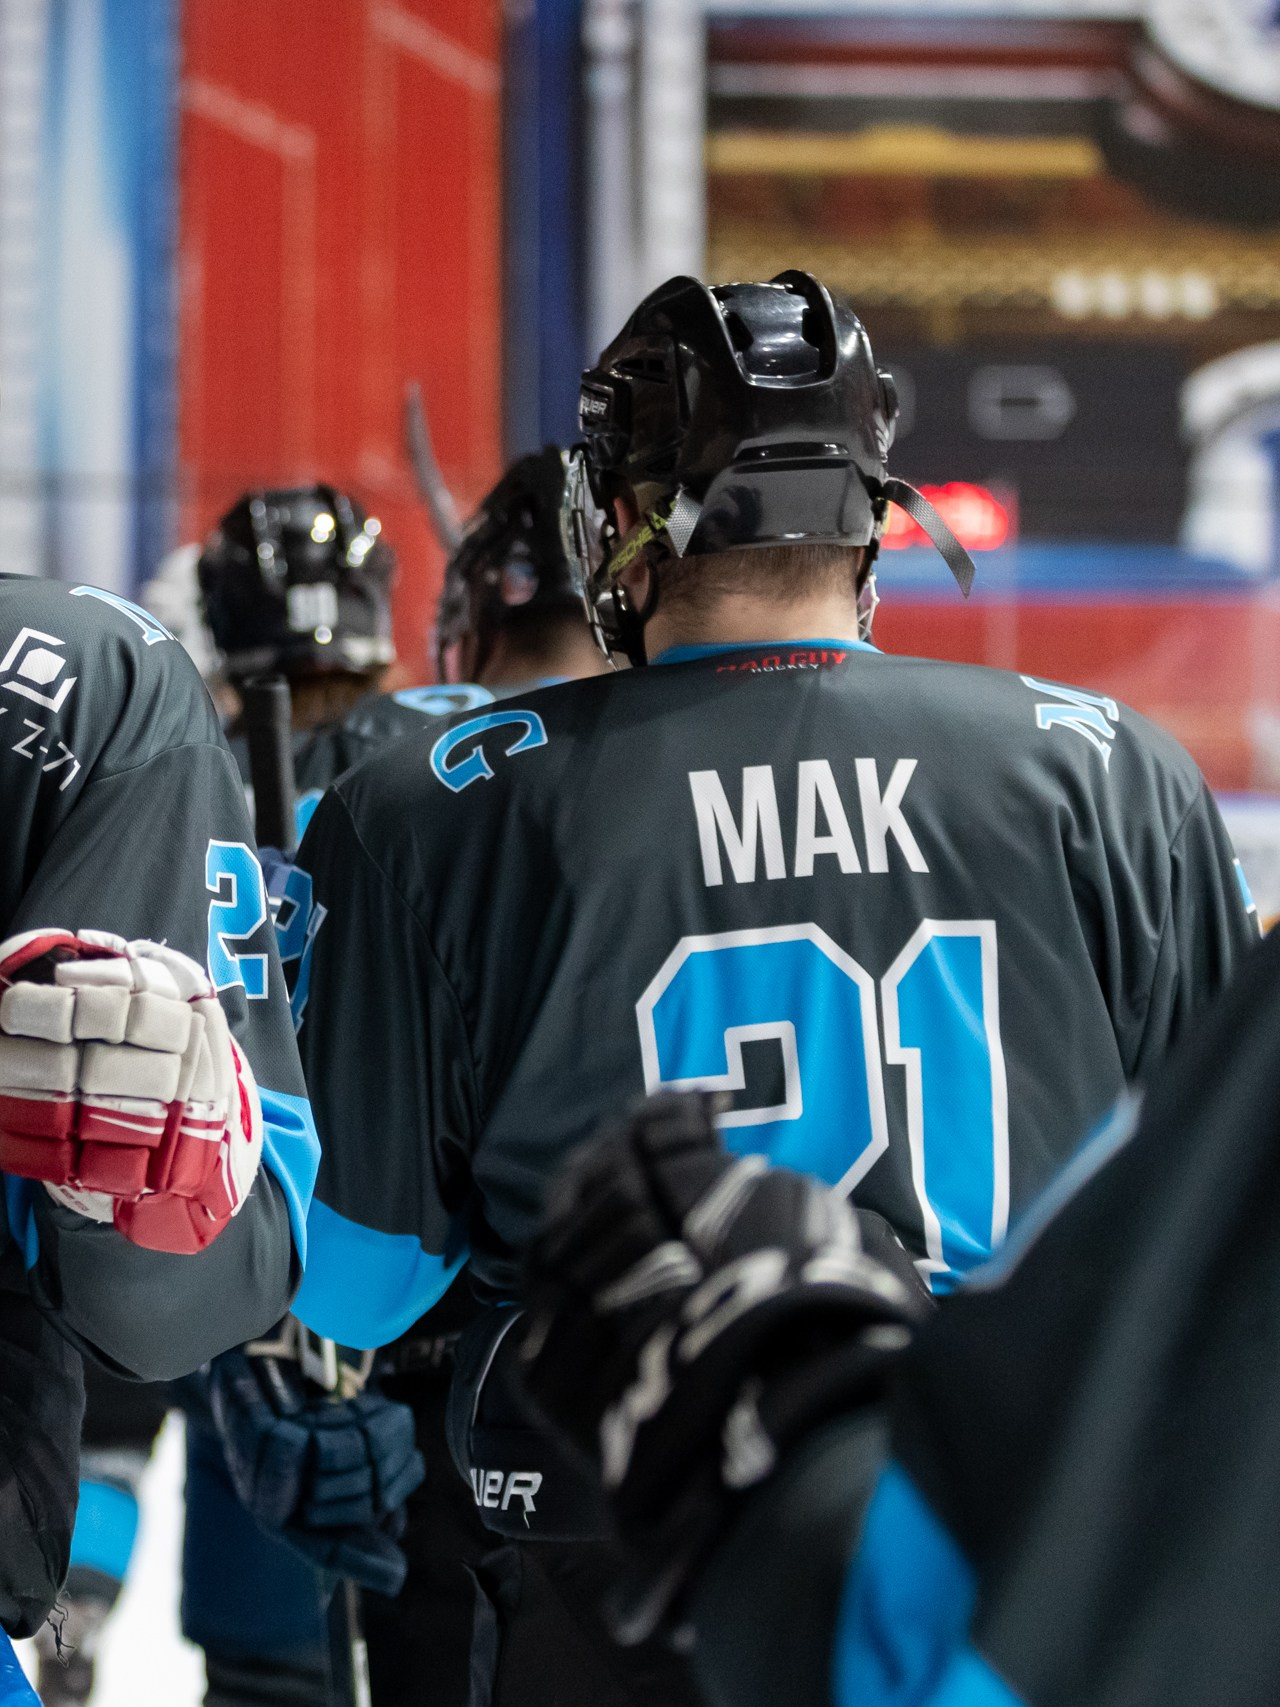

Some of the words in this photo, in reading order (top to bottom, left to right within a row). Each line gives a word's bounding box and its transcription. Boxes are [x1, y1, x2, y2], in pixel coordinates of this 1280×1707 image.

[751, 663, 819, 674] HOCKEY
[11, 718, 81, 792] Z-71
[429, 709, 549, 793] G
[688, 757, 930, 888] MAK
[205, 838, 270, 1000] 2
[635, 917, 1011, 1296] 21
